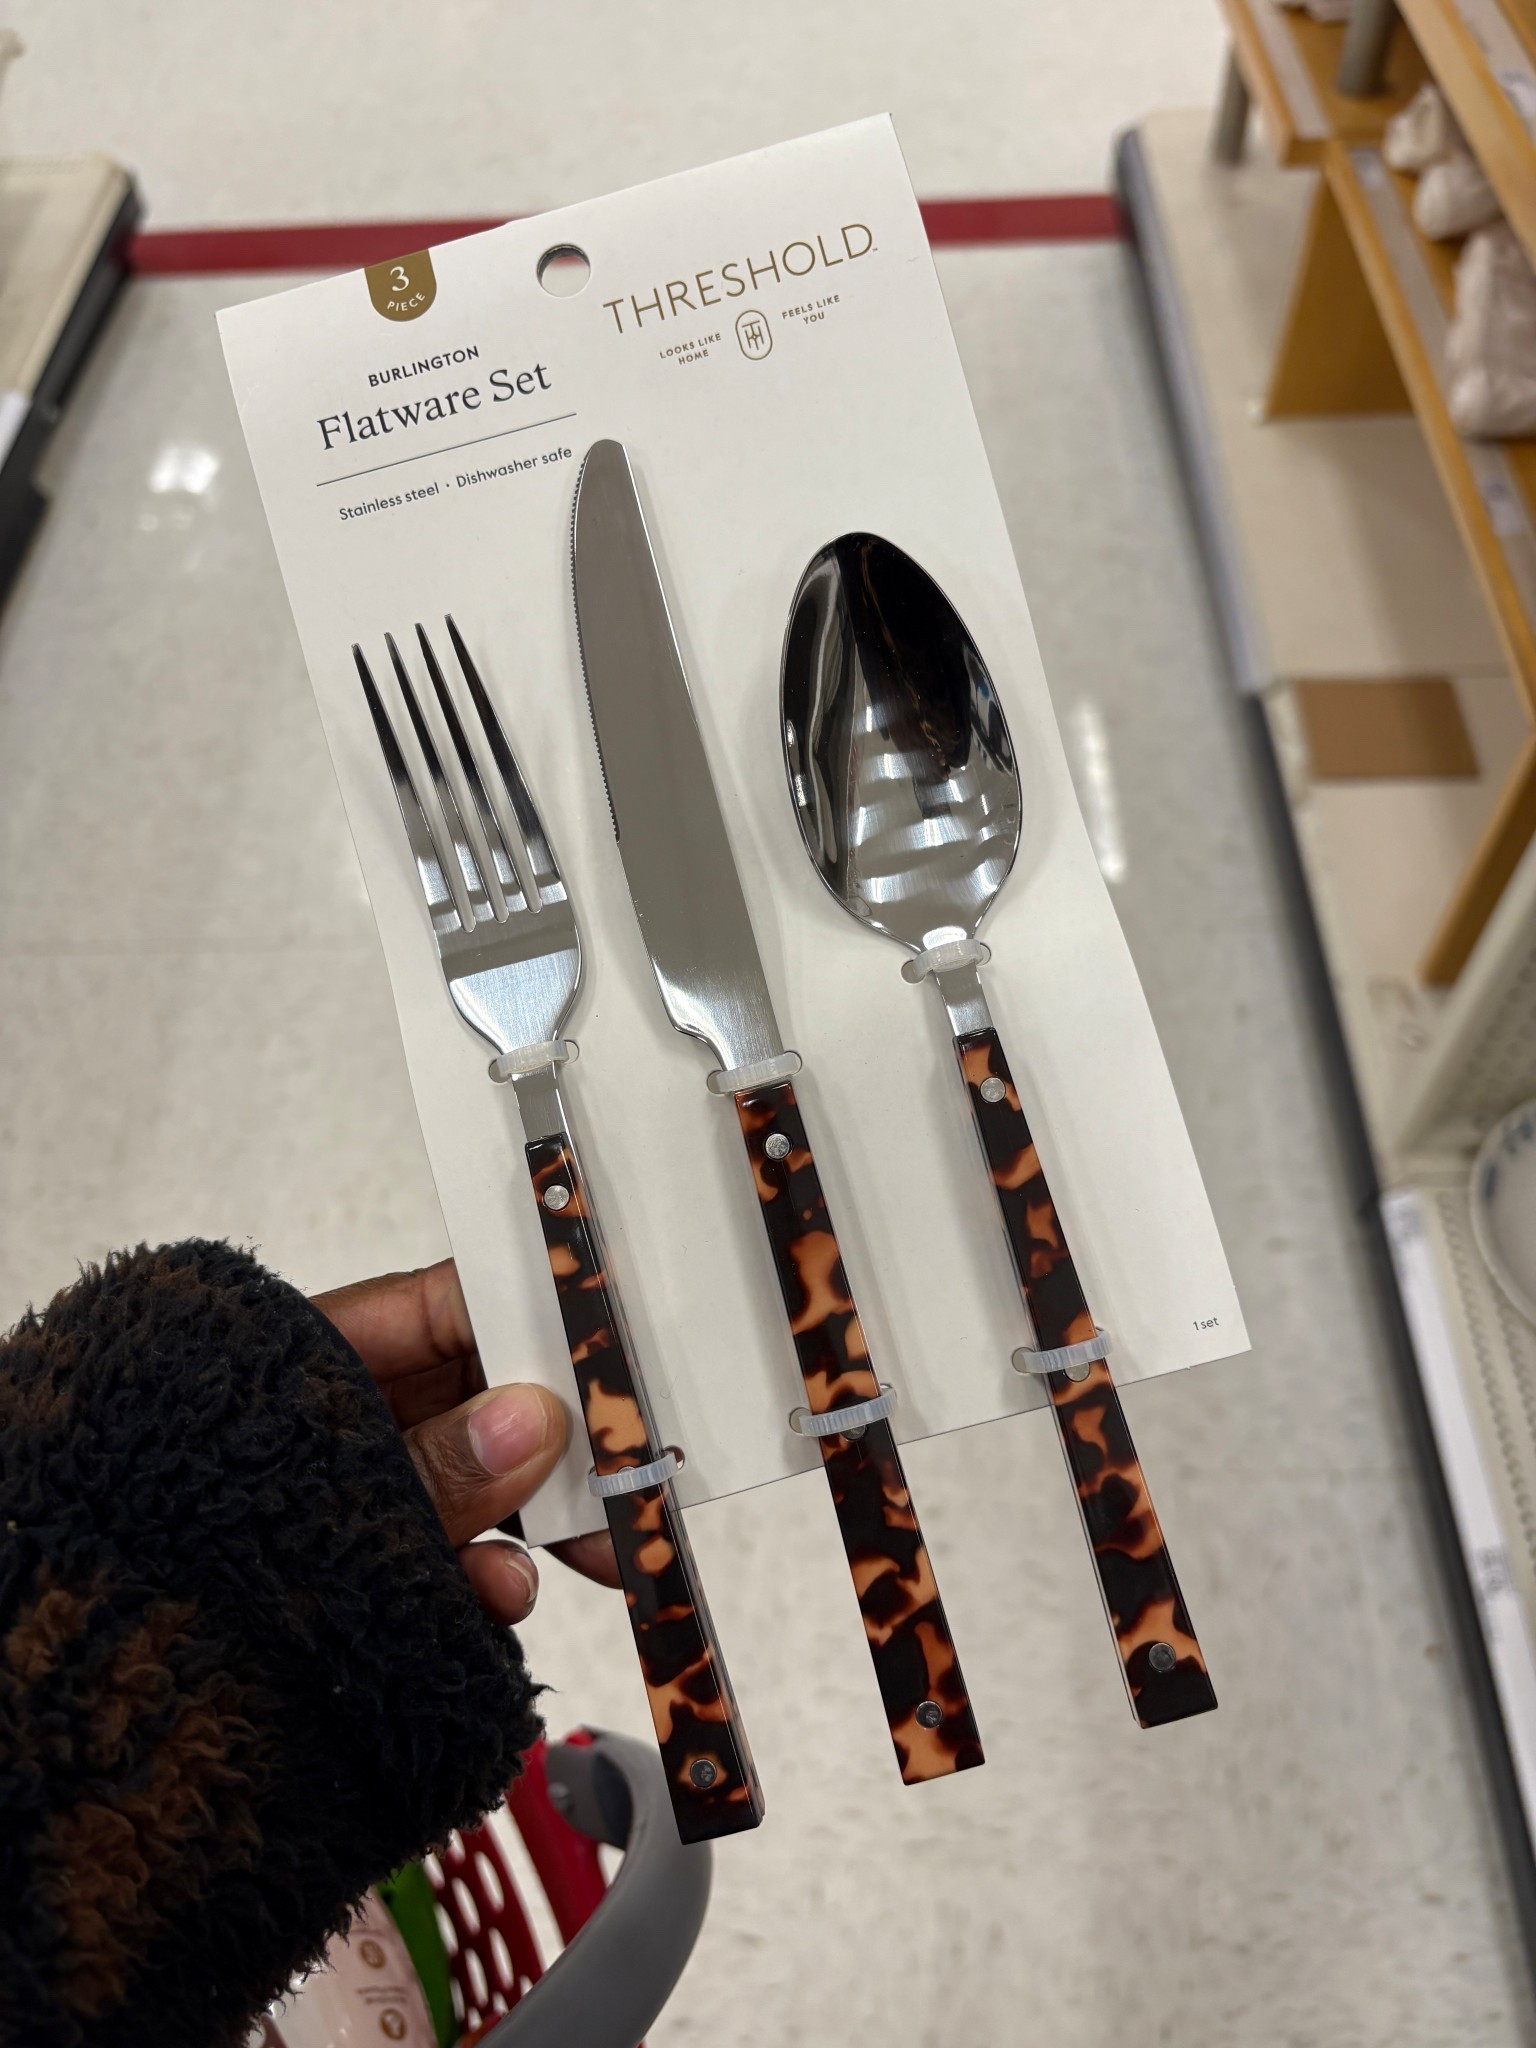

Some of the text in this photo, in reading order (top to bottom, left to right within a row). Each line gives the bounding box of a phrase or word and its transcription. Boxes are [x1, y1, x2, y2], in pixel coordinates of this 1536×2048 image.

[389, 265, 410, 292] 3
[602, 223, 873, 334] THRESHOLD
[386, 292, 426, 312] PIECE
[781, 294, 841, 320] FEELS LIKE
[802, 312, 826, 325] YOU
[659, 332, 722, 360] LOOKS LIKE
[678, 349, 709, 366] HOME
[368, 345, 480, 388] BURLINGTON
[316, 362, 552, 451] Flatware Set
[339, 447, 573, 521] Stainless steel Dishwasher safe
[1201, 1317, 1219, 1329] set
